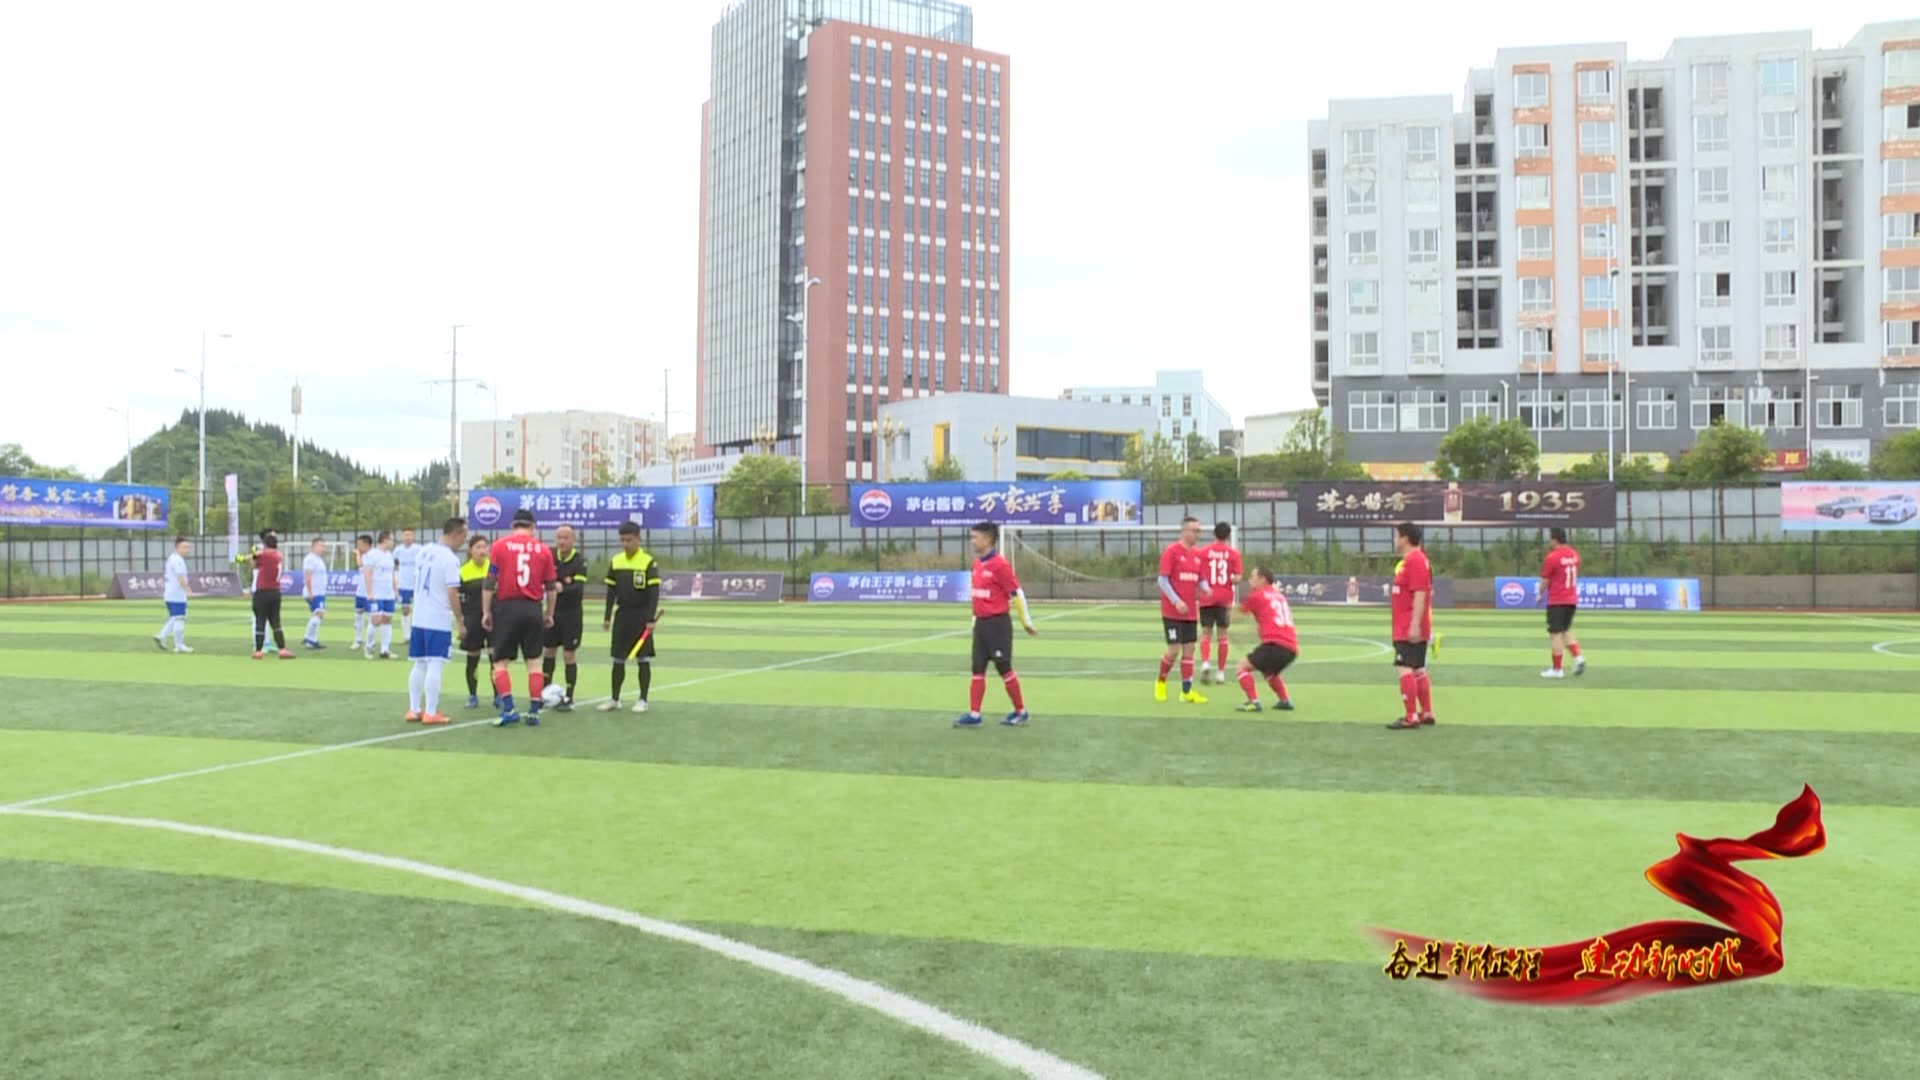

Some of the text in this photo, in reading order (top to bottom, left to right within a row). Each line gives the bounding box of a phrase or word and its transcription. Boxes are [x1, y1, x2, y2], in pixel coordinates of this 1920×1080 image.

[1499, 490, 1586, 512] 1935
[517, 554, 530, 587] 5
[1208, 559, 1228, 585] 13
[1564, 565, 1577, 589] 11
[721, 578, 767, 591] 1935
